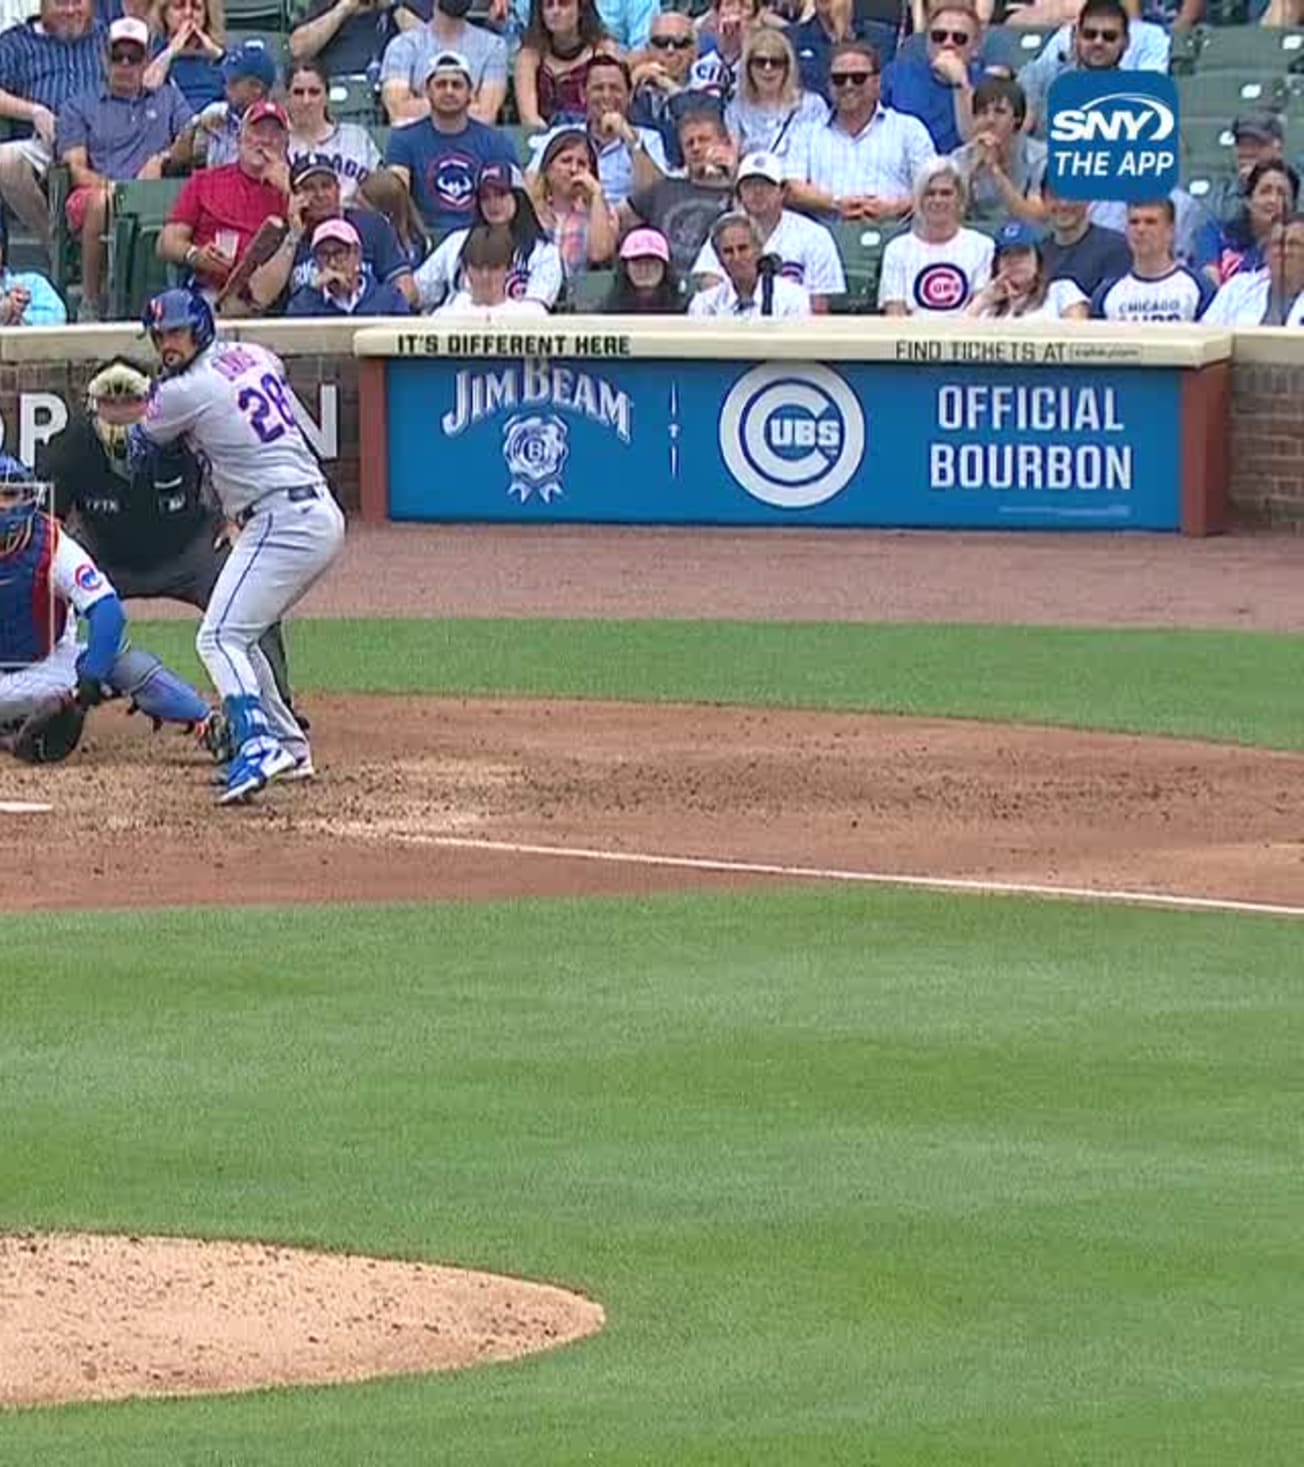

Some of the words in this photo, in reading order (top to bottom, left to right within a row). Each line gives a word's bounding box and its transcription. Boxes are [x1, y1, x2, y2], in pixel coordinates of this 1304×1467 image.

[1118, 299, 1181, 314] CHICAGO
[398, 334, 439, 354] IT'S
[447, 334, 567, 355] DIFFERENT
[574, 335, 631, 355] HERE
[895, 340, 942, 361] FIND
[950, 341, 1037, 361] TICKETS
[1042, 342, 1067, 361] AT
[442, 369, 518, 437] JIM
[523, 356, 632, 444] BEAM
[938, 385, 1125, 430] OFFICIAL
[930, 443, 1132, 489] BOURBON
